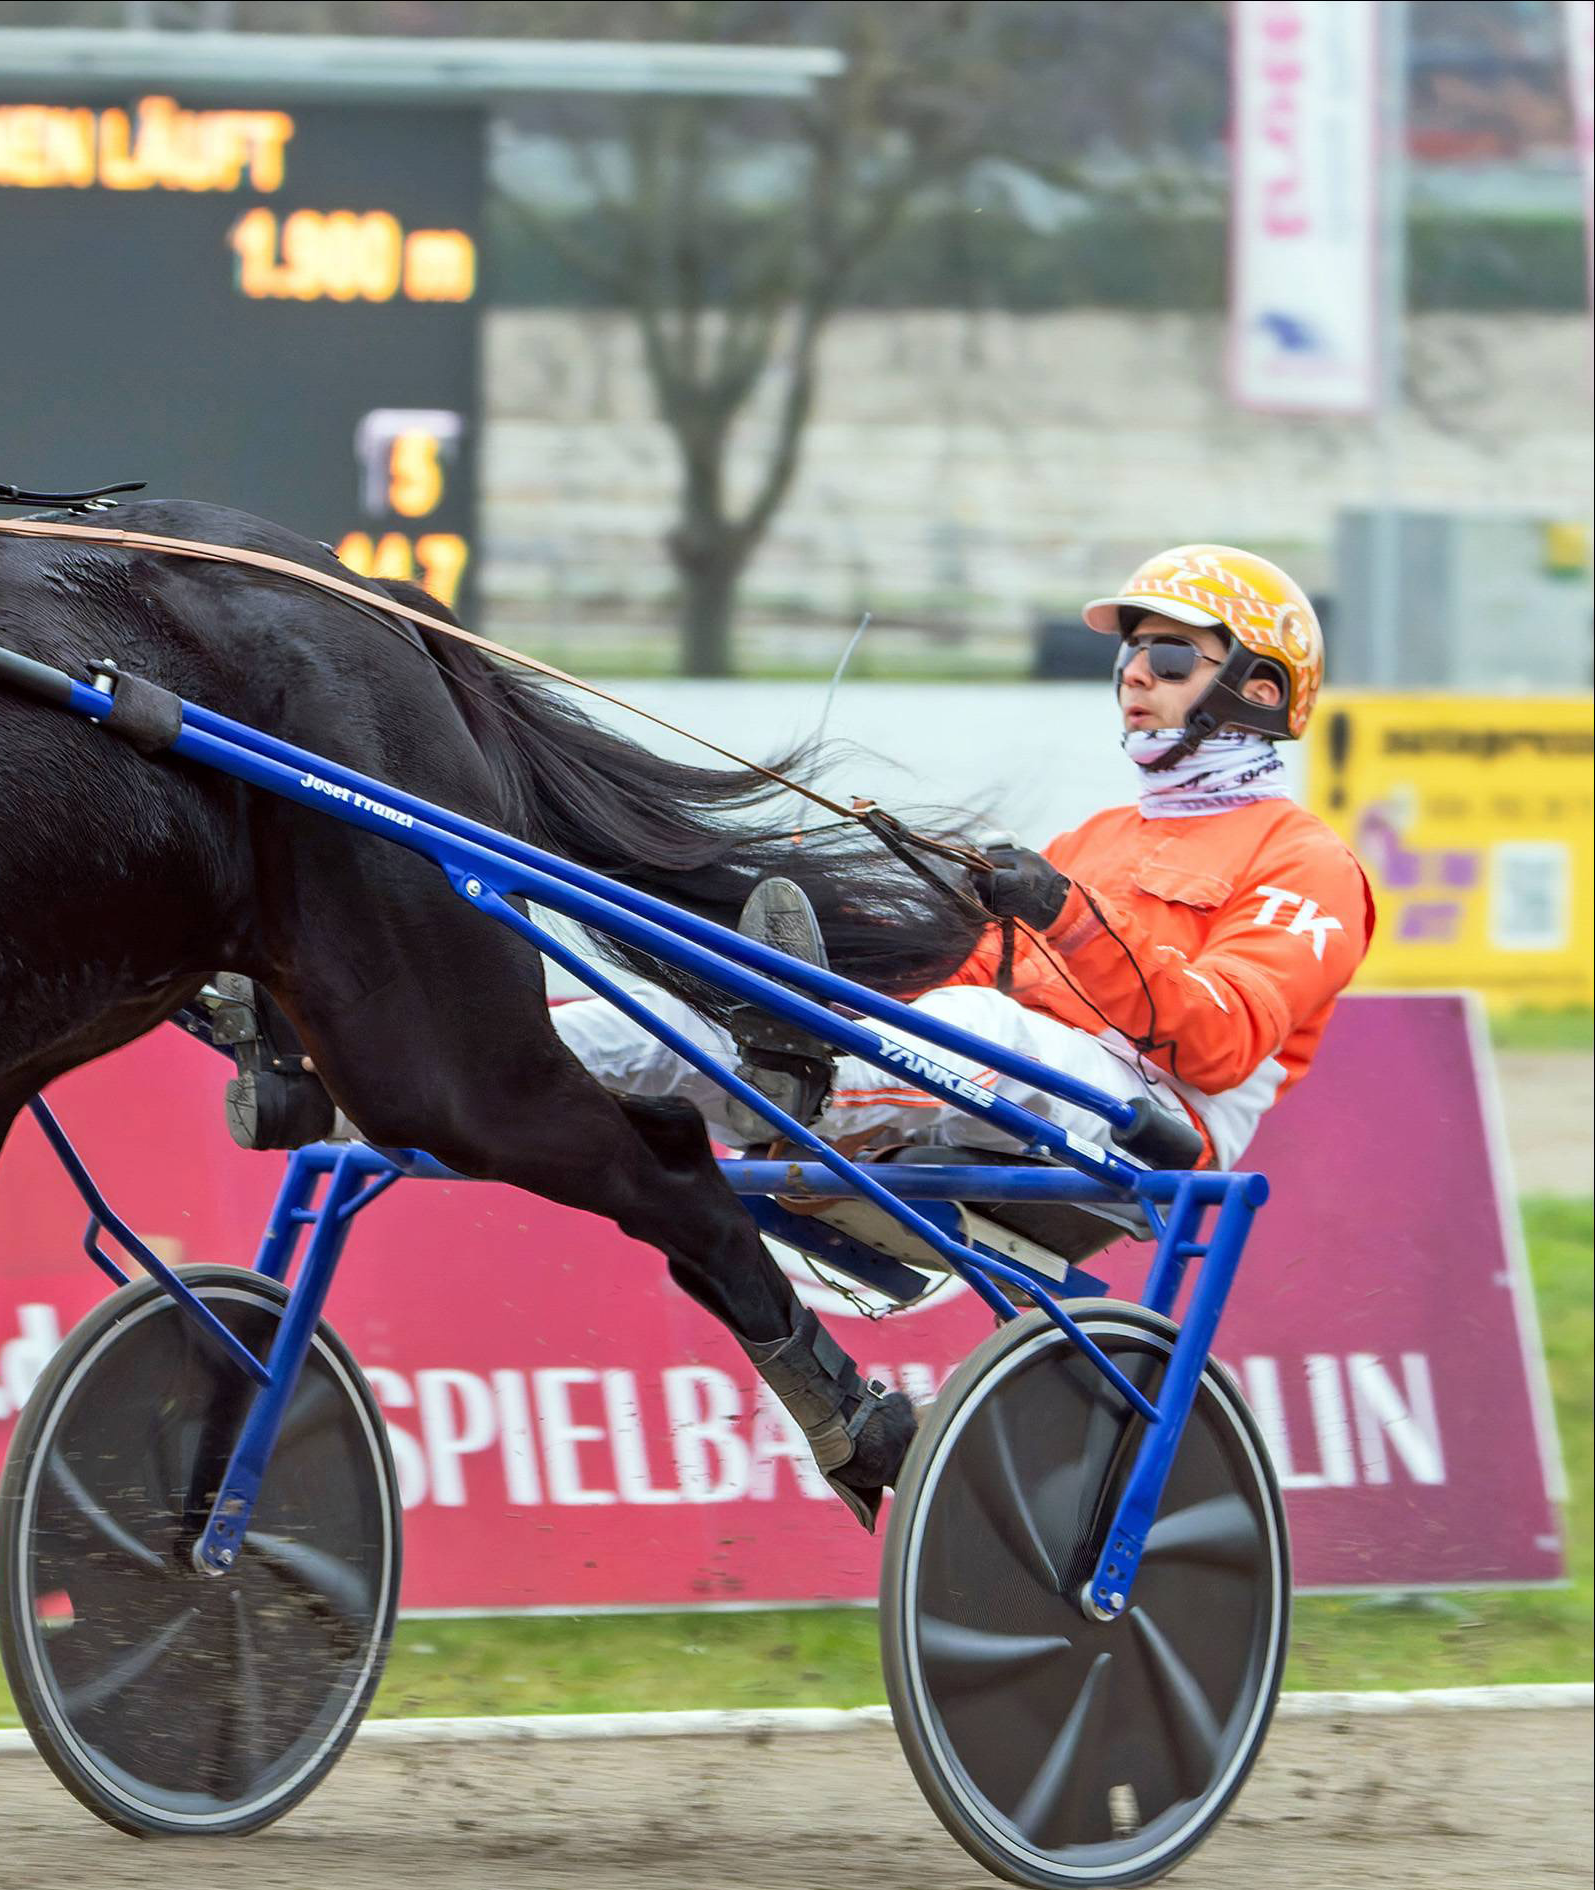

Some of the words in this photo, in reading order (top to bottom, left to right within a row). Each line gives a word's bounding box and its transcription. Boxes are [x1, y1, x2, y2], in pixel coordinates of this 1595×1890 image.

[1252, 885, 1343, 962] TK
[878, 1037, 998, 1109] YANKEE
[364, 1364, 954, 1509] SPIELBA
